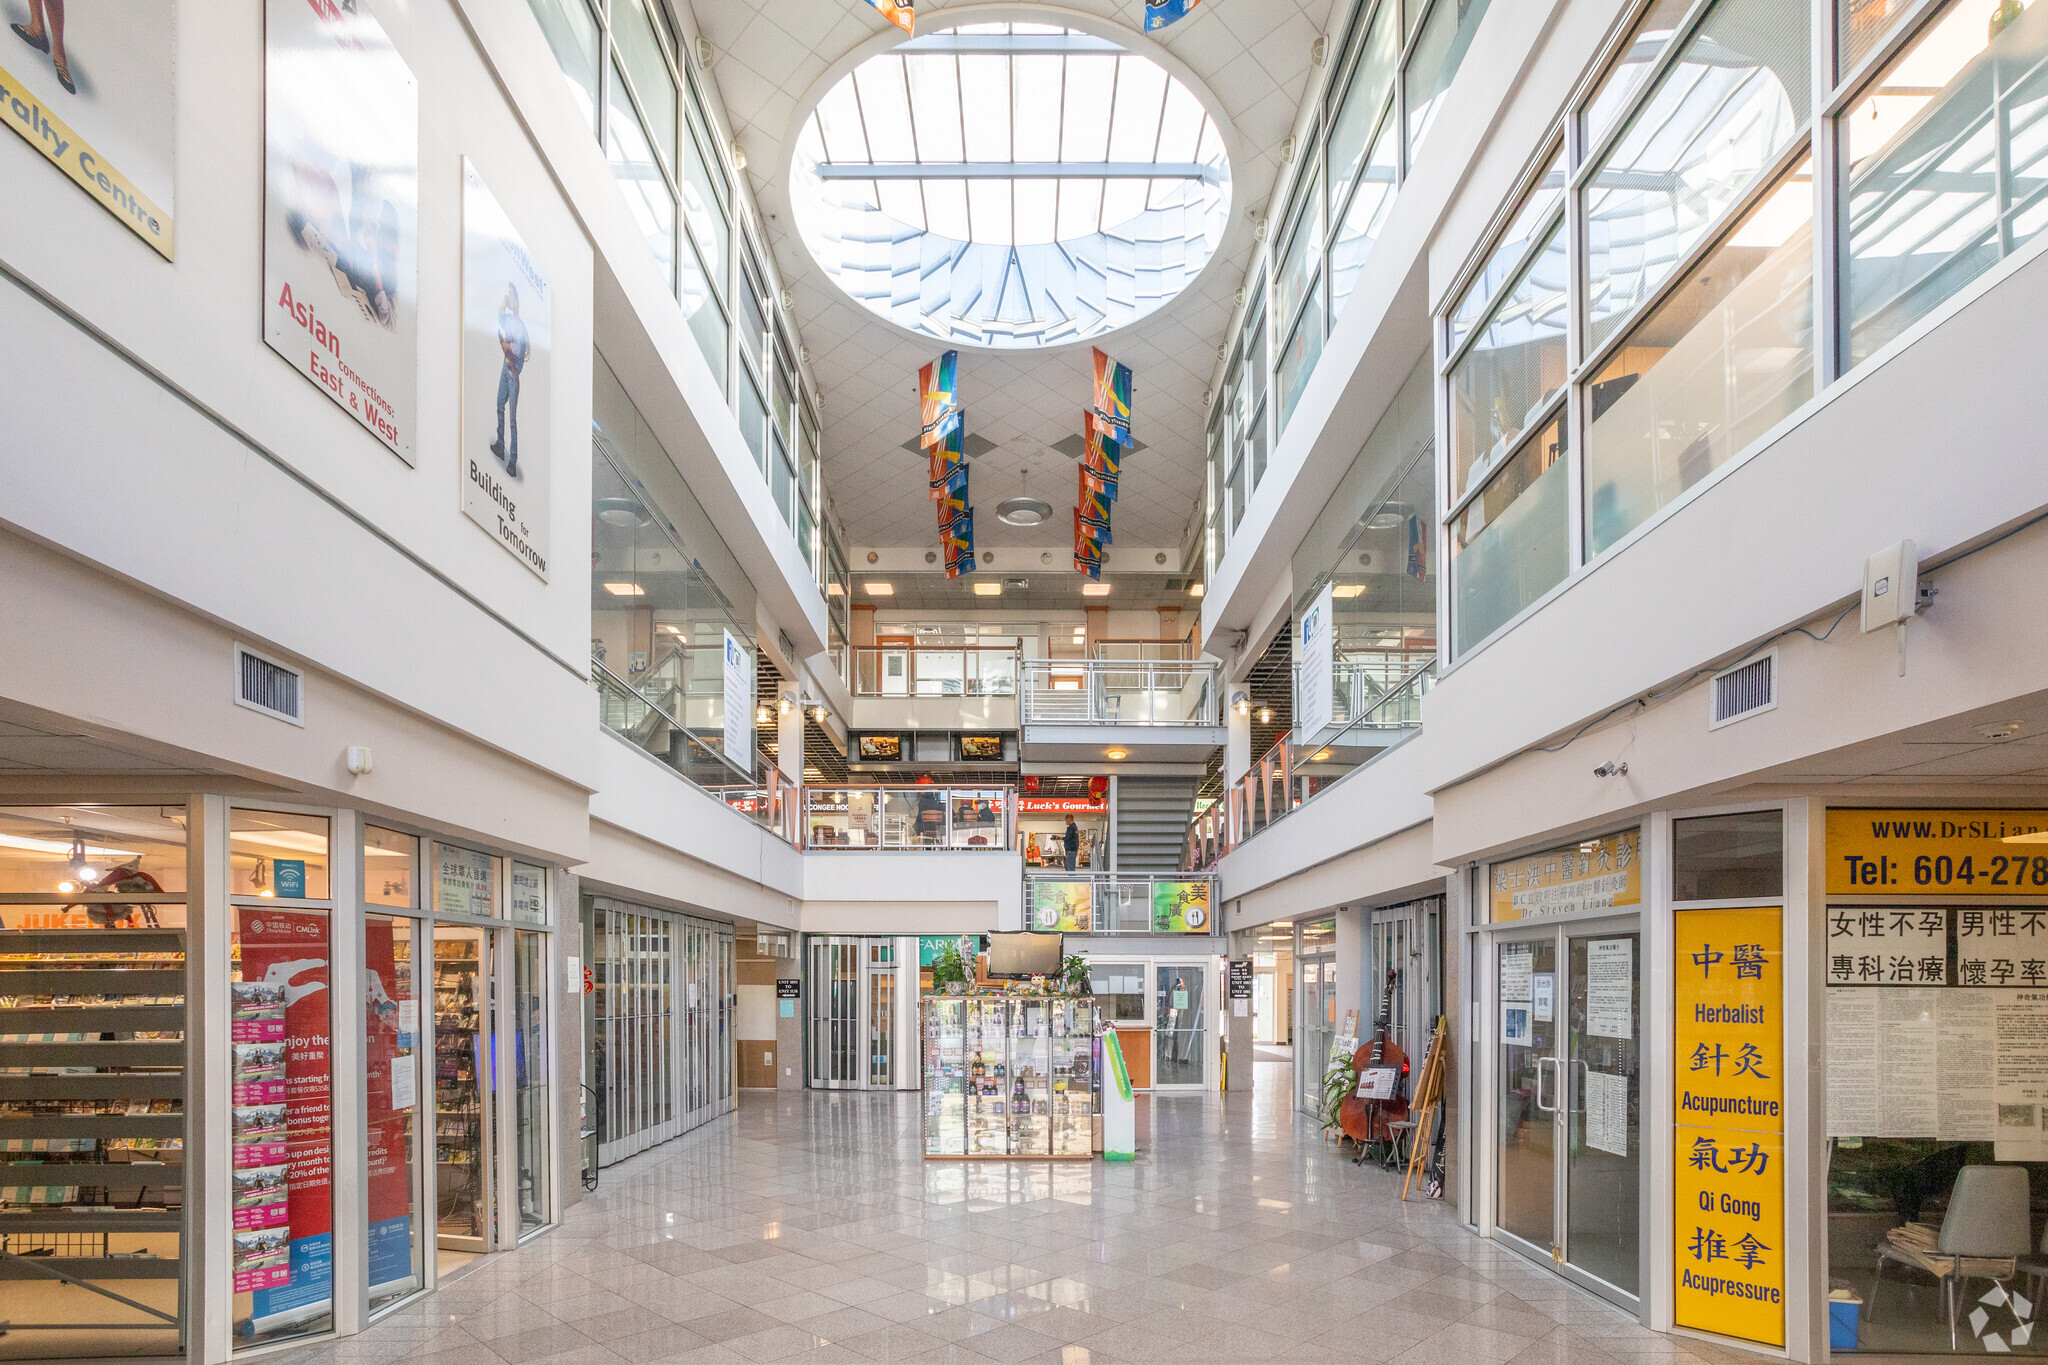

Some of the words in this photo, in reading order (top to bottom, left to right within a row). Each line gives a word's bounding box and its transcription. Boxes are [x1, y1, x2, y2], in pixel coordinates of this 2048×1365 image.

[79, 152, 161, 236] Centre
[278, 281, 340, 360] Asian
[338, 360, 395, 418] connections:
[310, 350, 344, 399] East
[349, 391, 359, 412] &
[364, 398, 398, 447] West
[470, 459, 516, 522] Building
[520, 522, 529, 538] for
[497, 514, 546, 573] Tomorrow
[1026, 802, 1060, 810] Luck's
[1871, 821, 2048, 839] WWW.DrSLian
[1844, 855, 1897, 885] Tel:
[1914, 855, 2048, 886] 604-278
[1039, 882, 1089, 931] 美食廣場
[1156, 883, 1208, 931] 美食廣場
[17, 913, 141, 929] JUKEX
[296, 925, 320, 935] CMLink
[1830, 911, 1944, 938] 女性不孕
[1961, 910, 2046, 938] 男性不
[1691, 943, 1769, 980] 中醫
[1830, 954, 1945, 982] 專科治療
[1960, 958, 2047, 986] 懷孕率
[1695, 1003, 1764, 1024] Herbalist
[277, 1035, 310, 1049] njoy
[1689, 1042, 1771, 1079] 針灸
[294, 1075, 323, 1085] starting
[300, 1104, 323, 1114] friend
[1681, 1091, 1779, 1116] Acupuncture
[287, 1116, 312, 1126] bonus
[291, 1150, 303, 1160] up
[303, 1149, 317, 1157] on
[297, 1158, 323, 1168] month
[1688, 1136, 1769, 1176] 氣功
[308, 1167, 317, 1176] of
[317, 1166, 330, 1175] the
[1699, 1190, 1714, 1212] Qi
[1720, 1193, 1761, 1221] Gong
[1687, 1226, 1773, 1270] 推拿
[1682, 1268, 1780, 1304] Acupressure
